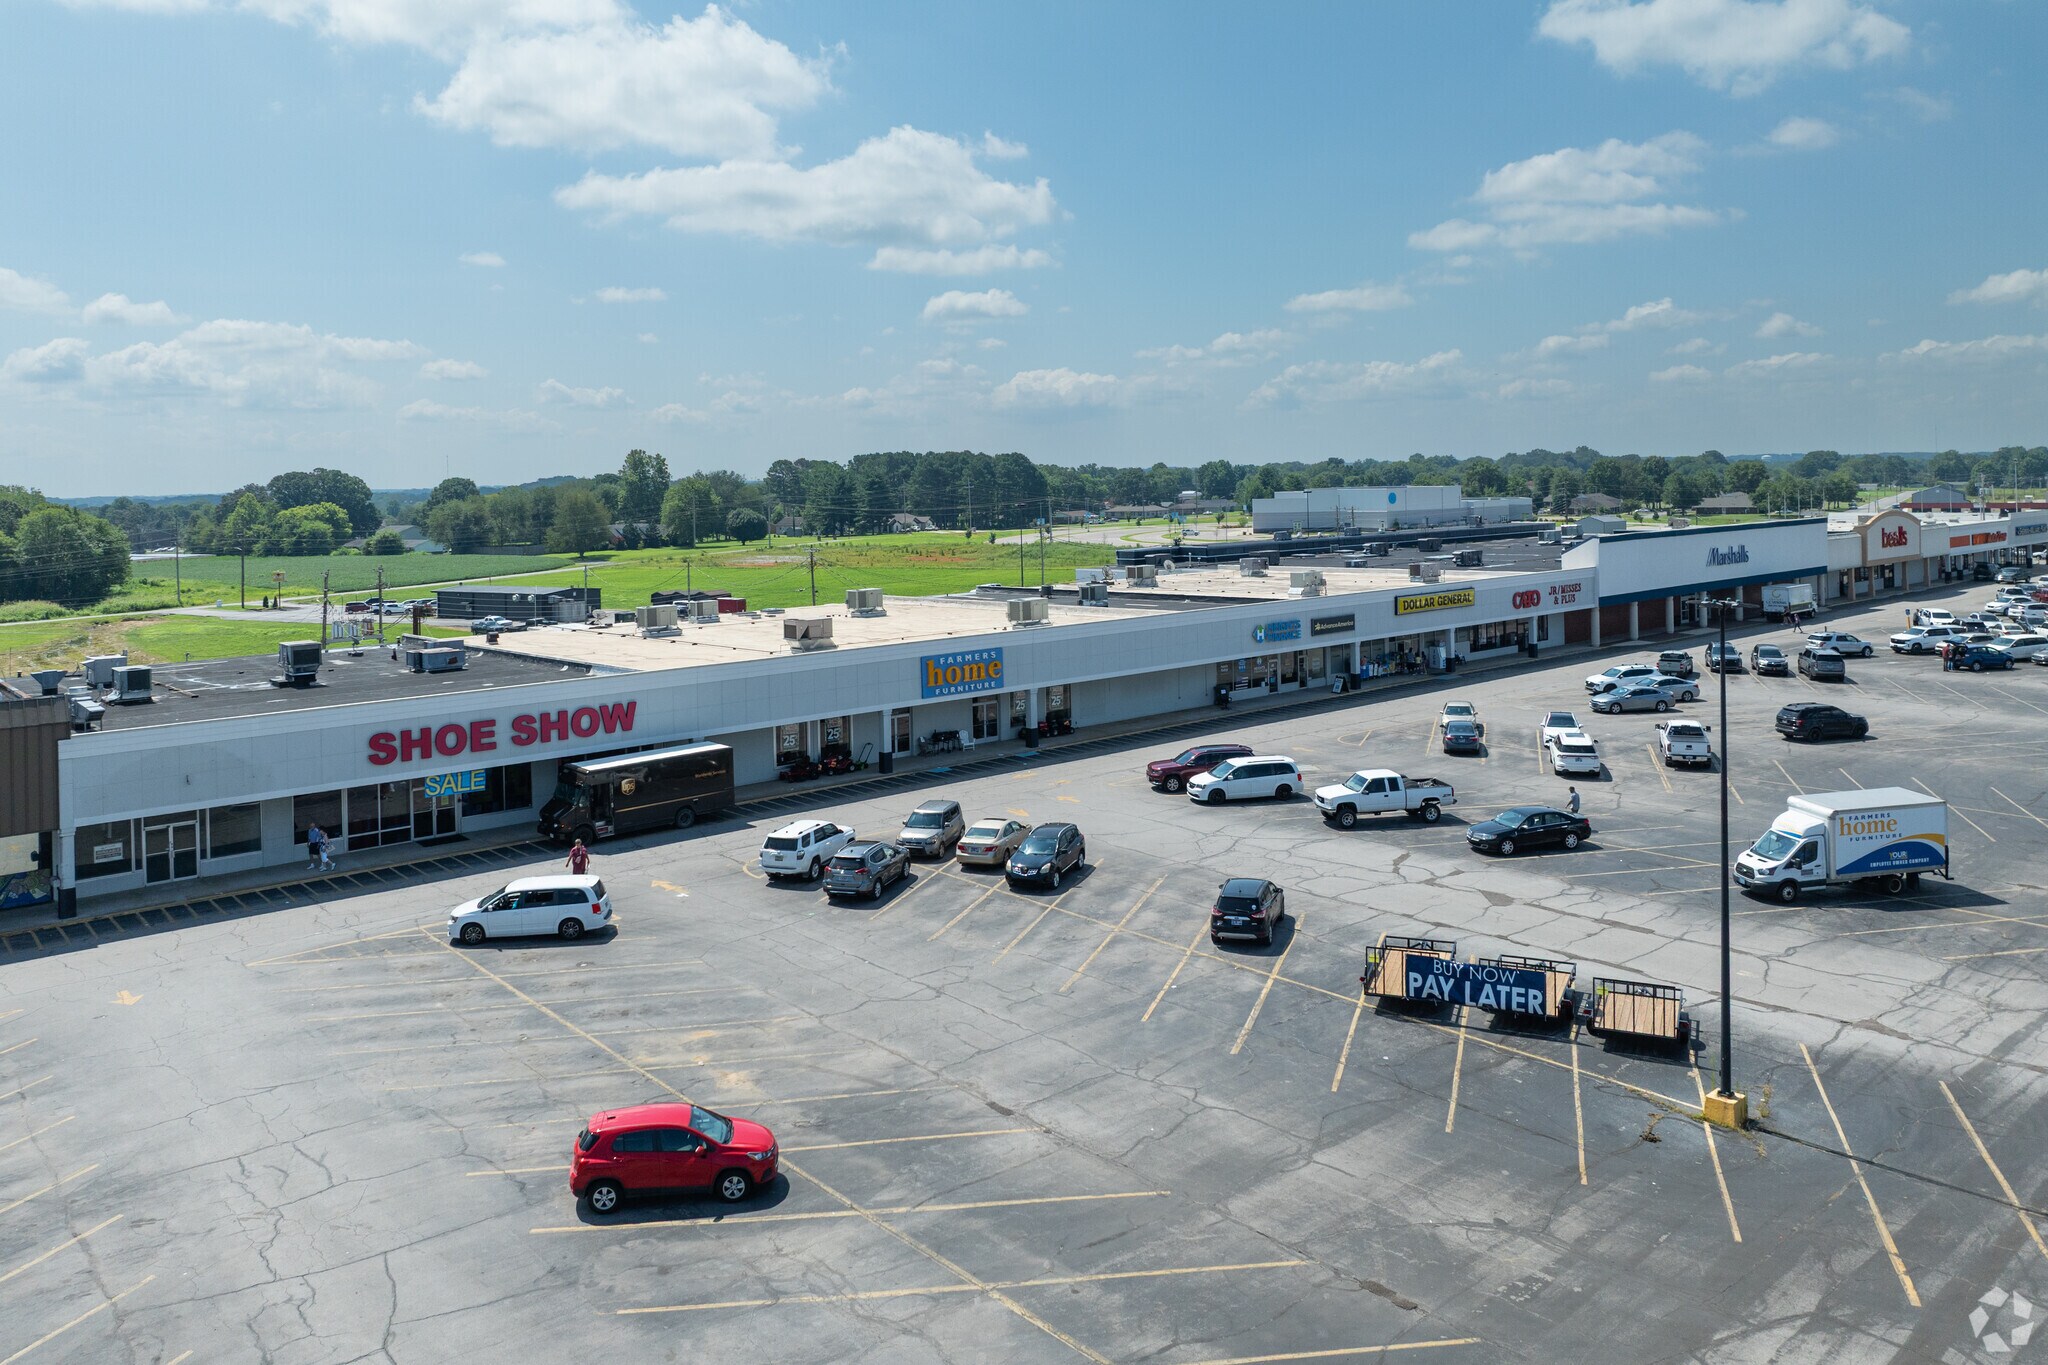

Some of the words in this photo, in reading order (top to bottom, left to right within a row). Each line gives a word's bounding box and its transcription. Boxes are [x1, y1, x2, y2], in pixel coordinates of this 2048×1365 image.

[1706, 544, 1749, 567] Marshalls
[1402, 596, 1435, 611] DOLLAR
[1437, 592, 1473, 606] GENERAL
[1512, 589, 1541, 610] CATO
[940, 651, 997, 665] FARMERS
[927, 660, 1002, 687] home
[935, 681, 996, 695] FURNITURE
[368, 719, 497, 766] SHOE
[511, 701, 637, 747] SHOW
[425, 769, 486, 796] SALE
[622, 781, 636, 794] ups
[1839, 817, 1898, 836] home
[1849, 812, 1892, 821] FARMERS
[1850, 833, 1902, 842] FURNITURE
[1433, 958, 1464, 979] BUY
[1469, 965, 1517, 985] NOW
[1408, 971, 1454, 1000] PAY
[1465, 981, 1544, 1015] LATER
